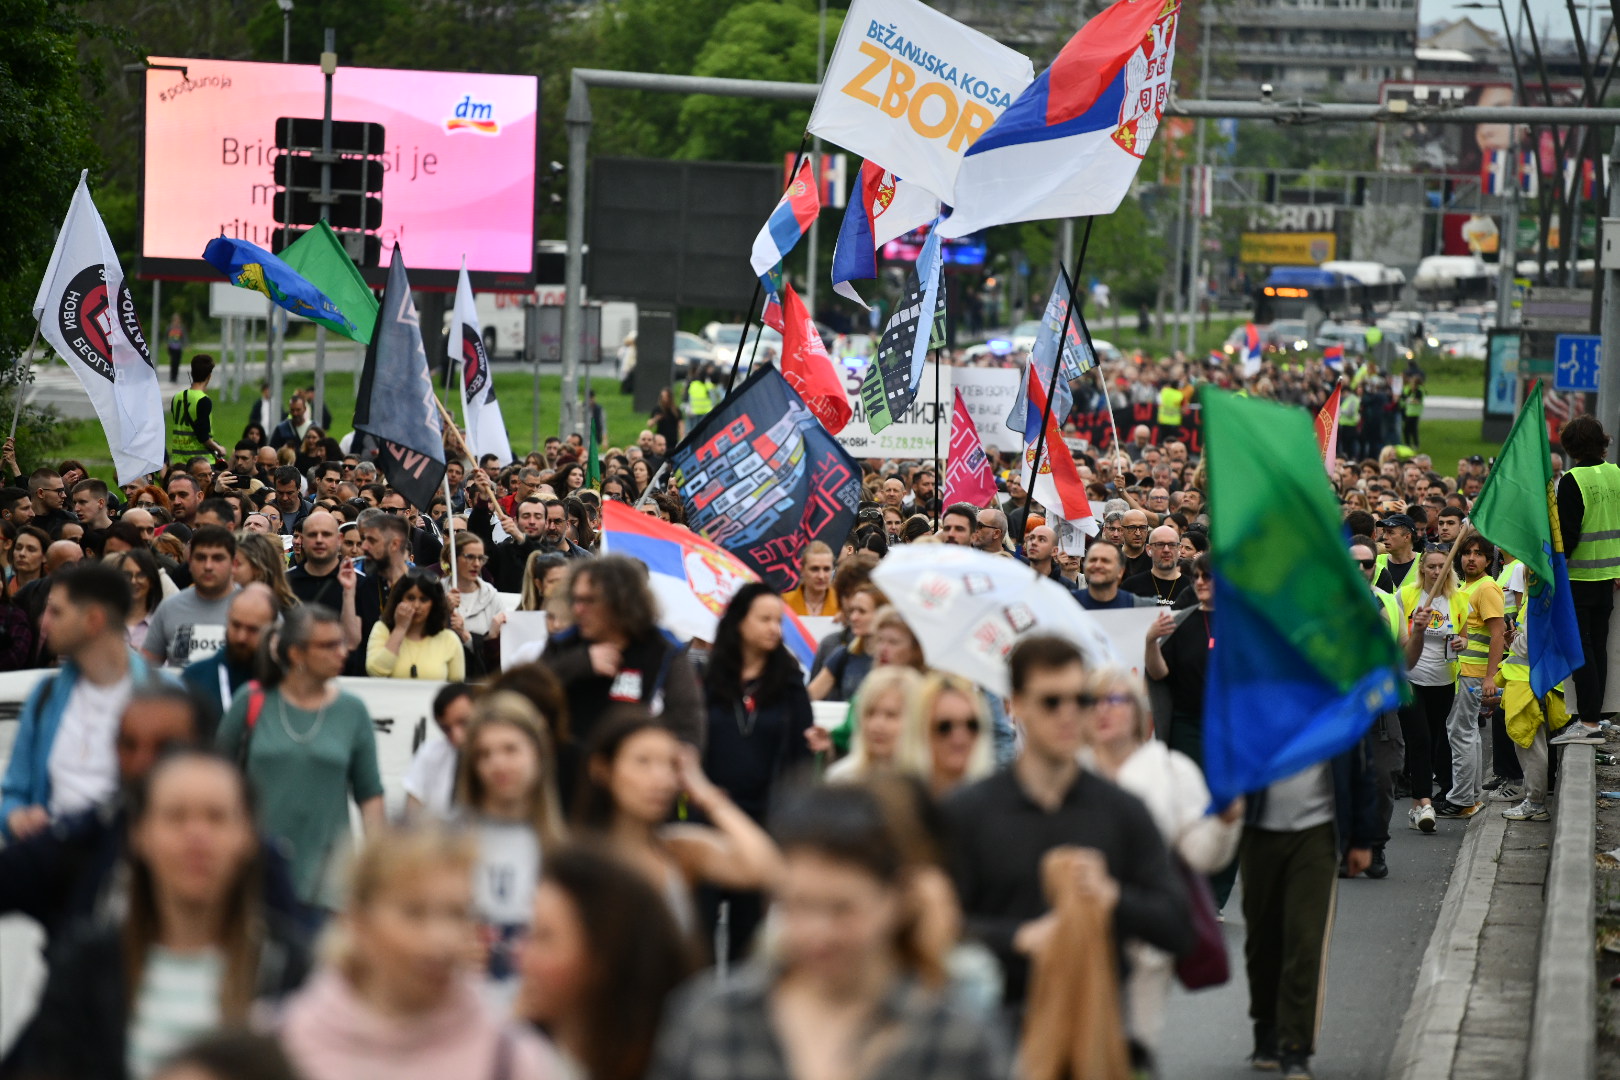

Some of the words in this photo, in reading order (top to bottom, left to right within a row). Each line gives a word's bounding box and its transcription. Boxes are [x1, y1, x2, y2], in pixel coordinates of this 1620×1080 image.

[455, 96, 493, 119] dm
[840, 41, 995, 152] ZBOR
[960, 73, 1011, 108] KOSA
[223, 137, 277, 174] Brig
[411, 146, 438, 181] je
[63, 290, 81, 330] НОВИ
[837, 437, 868, 448] ОКОВИ
